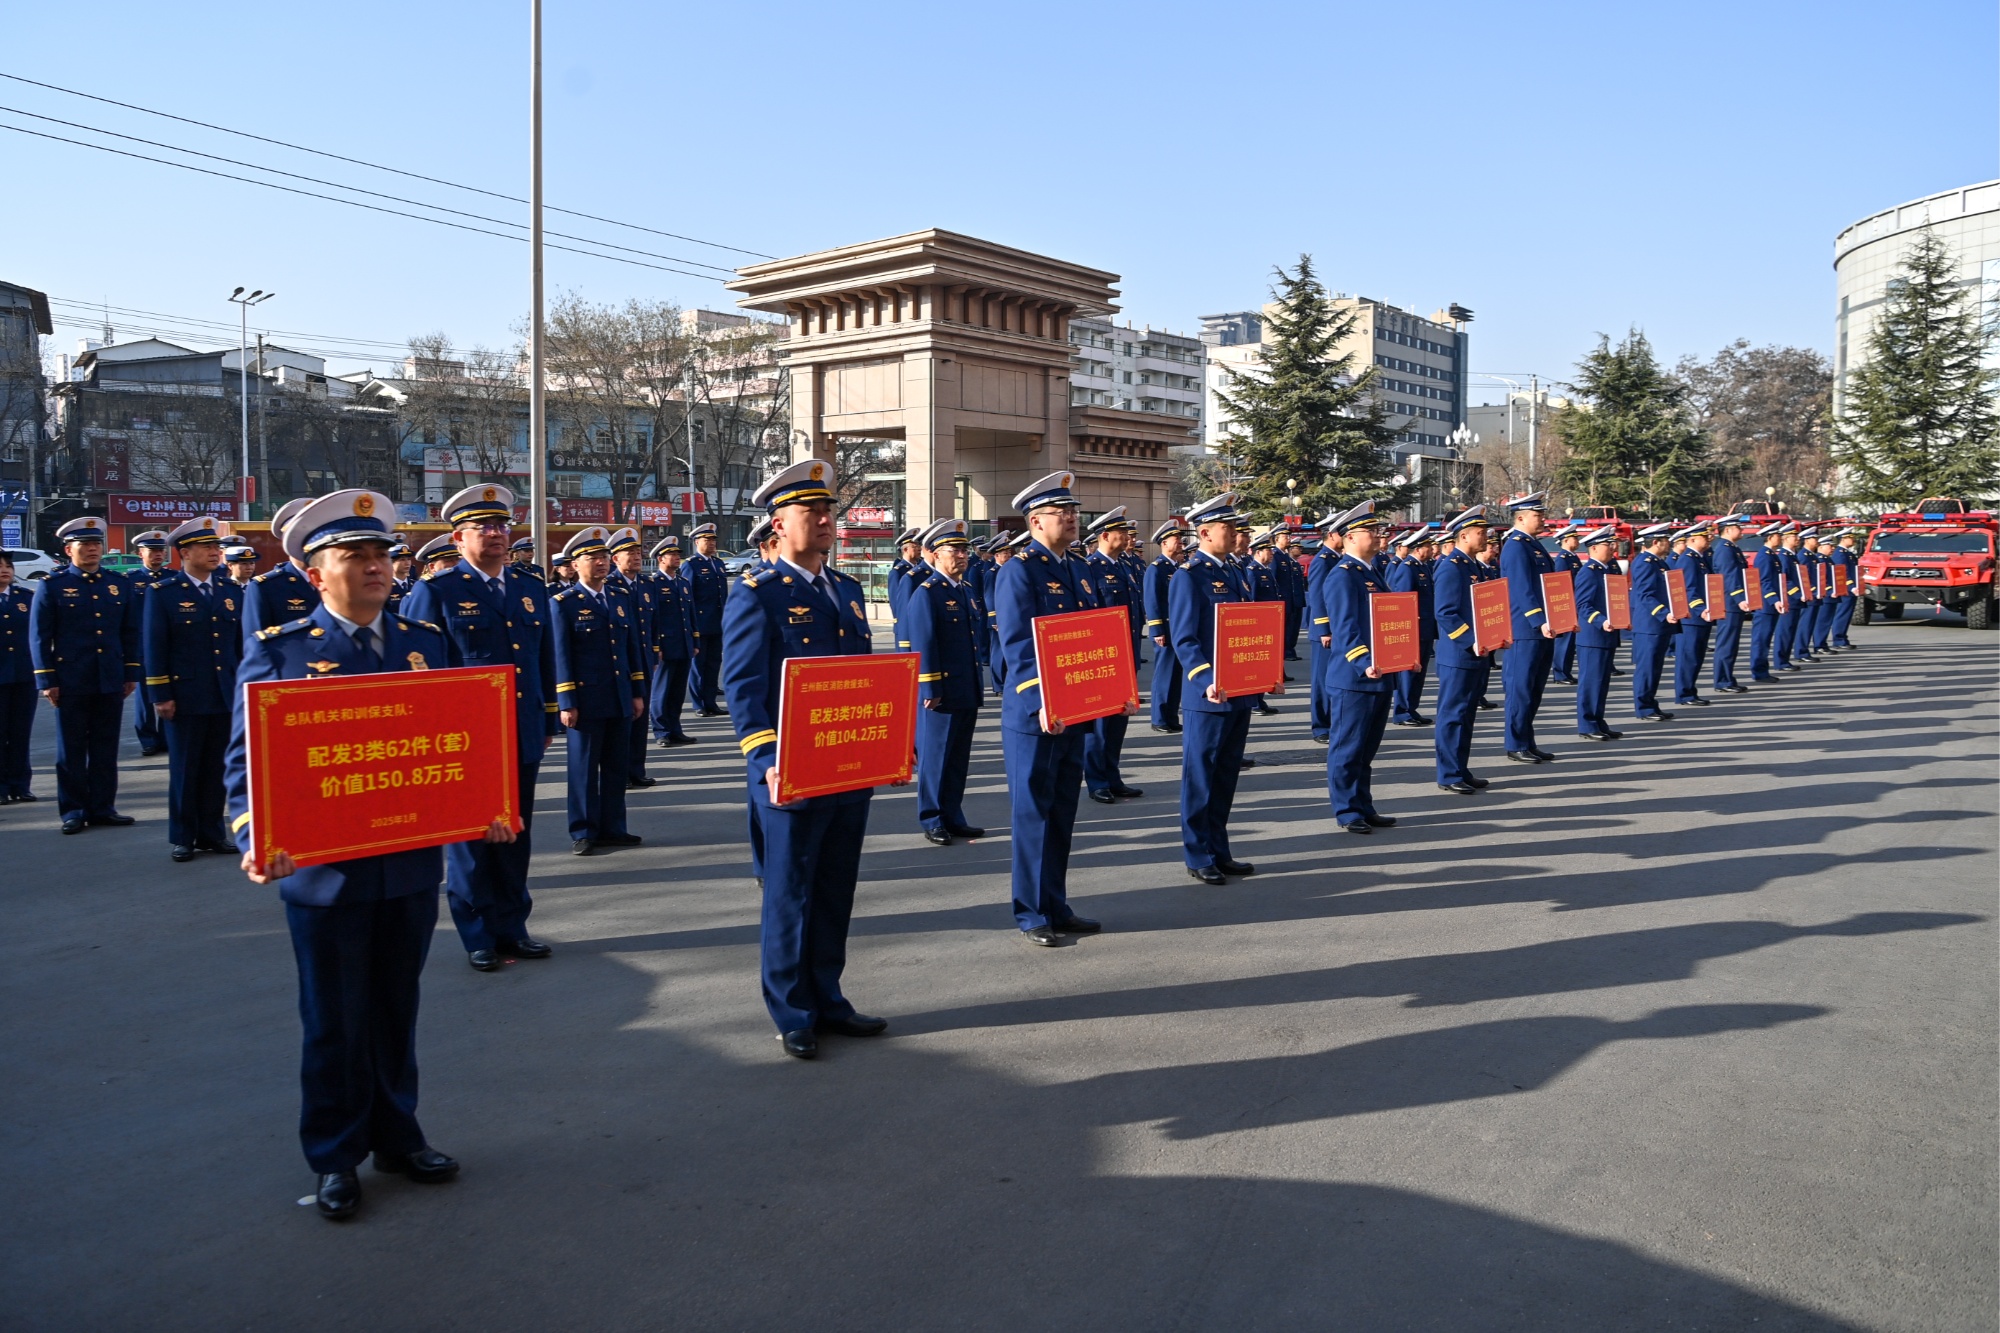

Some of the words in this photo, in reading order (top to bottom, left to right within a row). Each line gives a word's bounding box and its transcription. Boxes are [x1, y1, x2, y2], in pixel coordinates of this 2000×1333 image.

[1055, 645, 1118, 668] 配发3类146件(套)
[1064, 664, 1117, 685] 价值485.2万元
[283, 703, 414, 727] 总队机关和训保支队:
[809, 701, 894, 725] 配发3类79件(套)
[814, 725, 888, 748] 价值104.2万元
[307, 731, 471, 768] 配发3类62件(套)
[836, 762, 862, 772] 2025年1月
[320, 762, 465, 798] 价值150.8万元
[370, 812, 417, 828] 2025年1月
